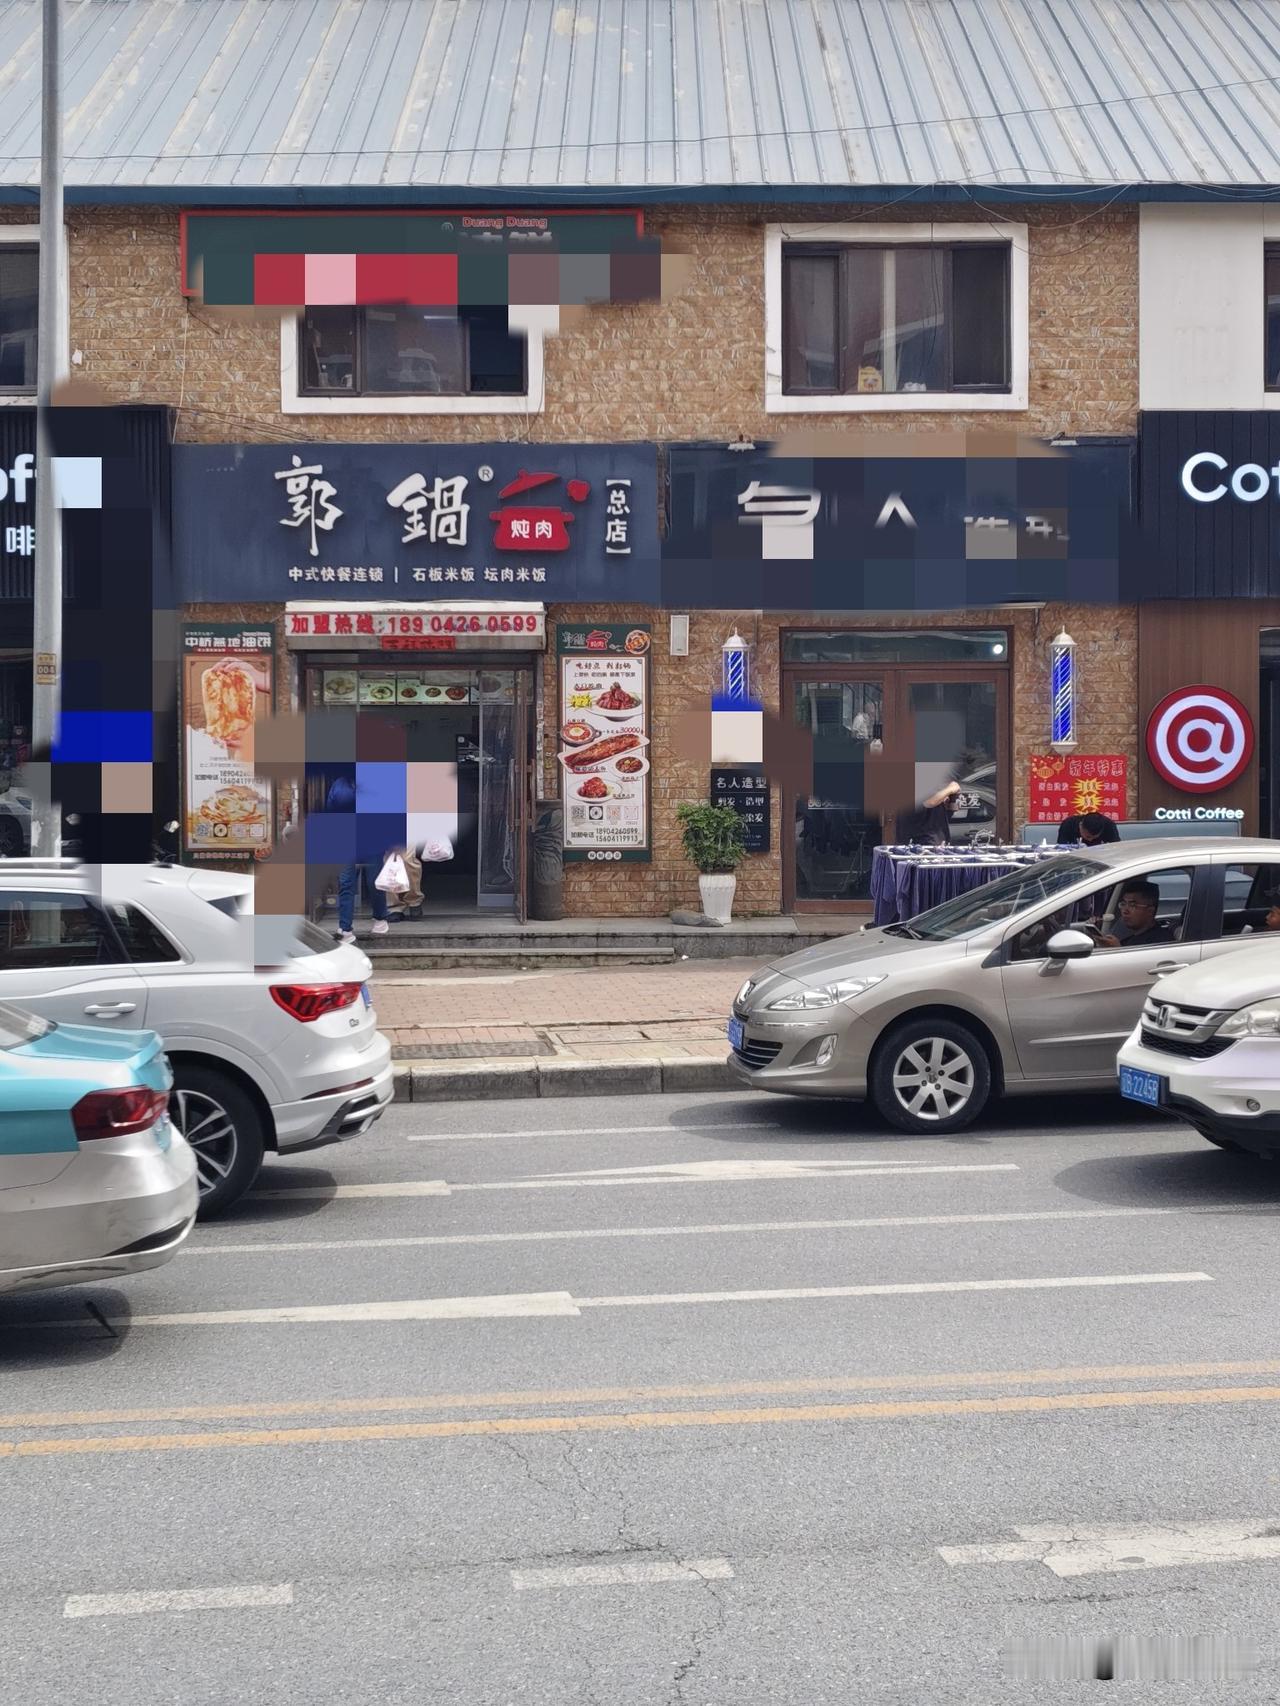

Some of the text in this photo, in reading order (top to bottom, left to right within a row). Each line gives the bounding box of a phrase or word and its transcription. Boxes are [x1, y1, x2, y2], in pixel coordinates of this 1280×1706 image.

[462, 216, 547, 230] Duang Duang
[511, 519, 553, 539] 炖肉
[288, 566, 547, 583] 中式快餐连锁 石板米饭 坛肉米饭
[716, 776, 768, 789] 名人造型
[1155, 806, 1244, 820] Cotti Coffee
